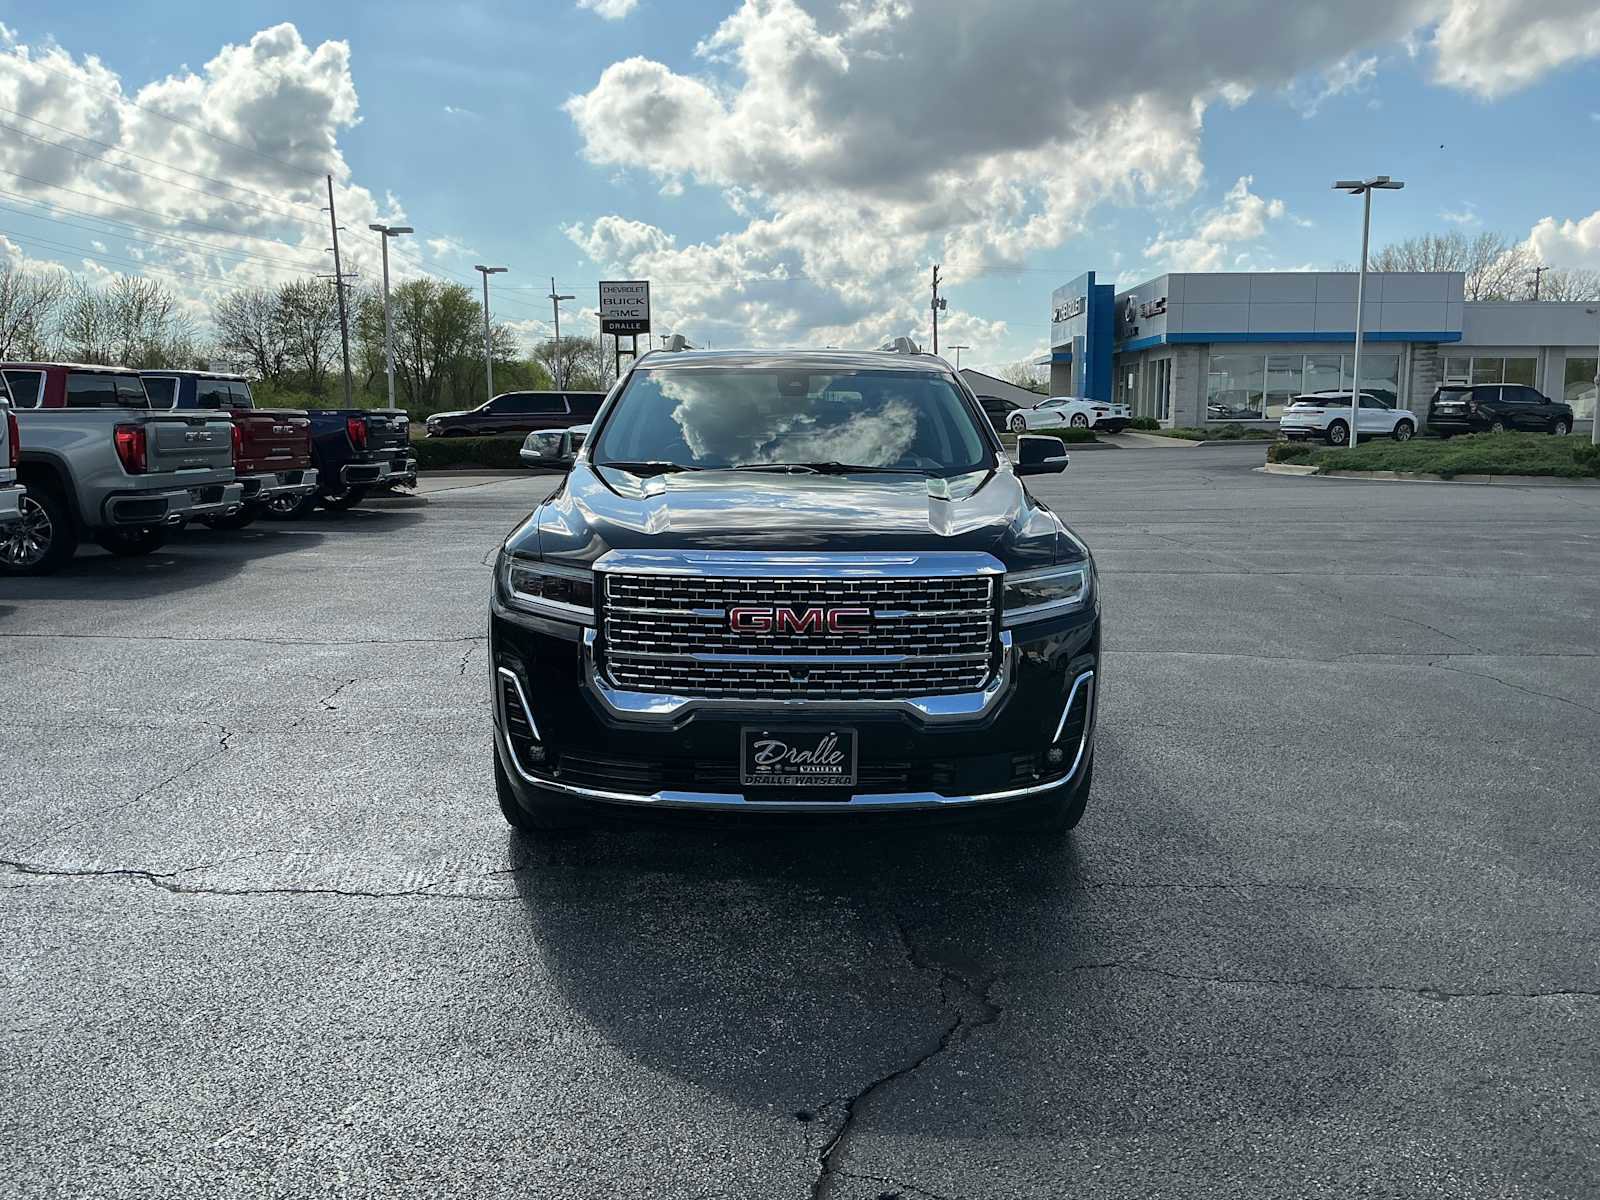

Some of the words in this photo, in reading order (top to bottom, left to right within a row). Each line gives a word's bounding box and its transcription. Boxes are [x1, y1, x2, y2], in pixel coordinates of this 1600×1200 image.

[609, 322, 641, 330] DRALLE
[729, 607, 870, 633] GMC
[753, 735, 845, 764] Dralle
[745, 776, 791, 785] DRALLE
[795, 776, 851, 785] WATSEKA
